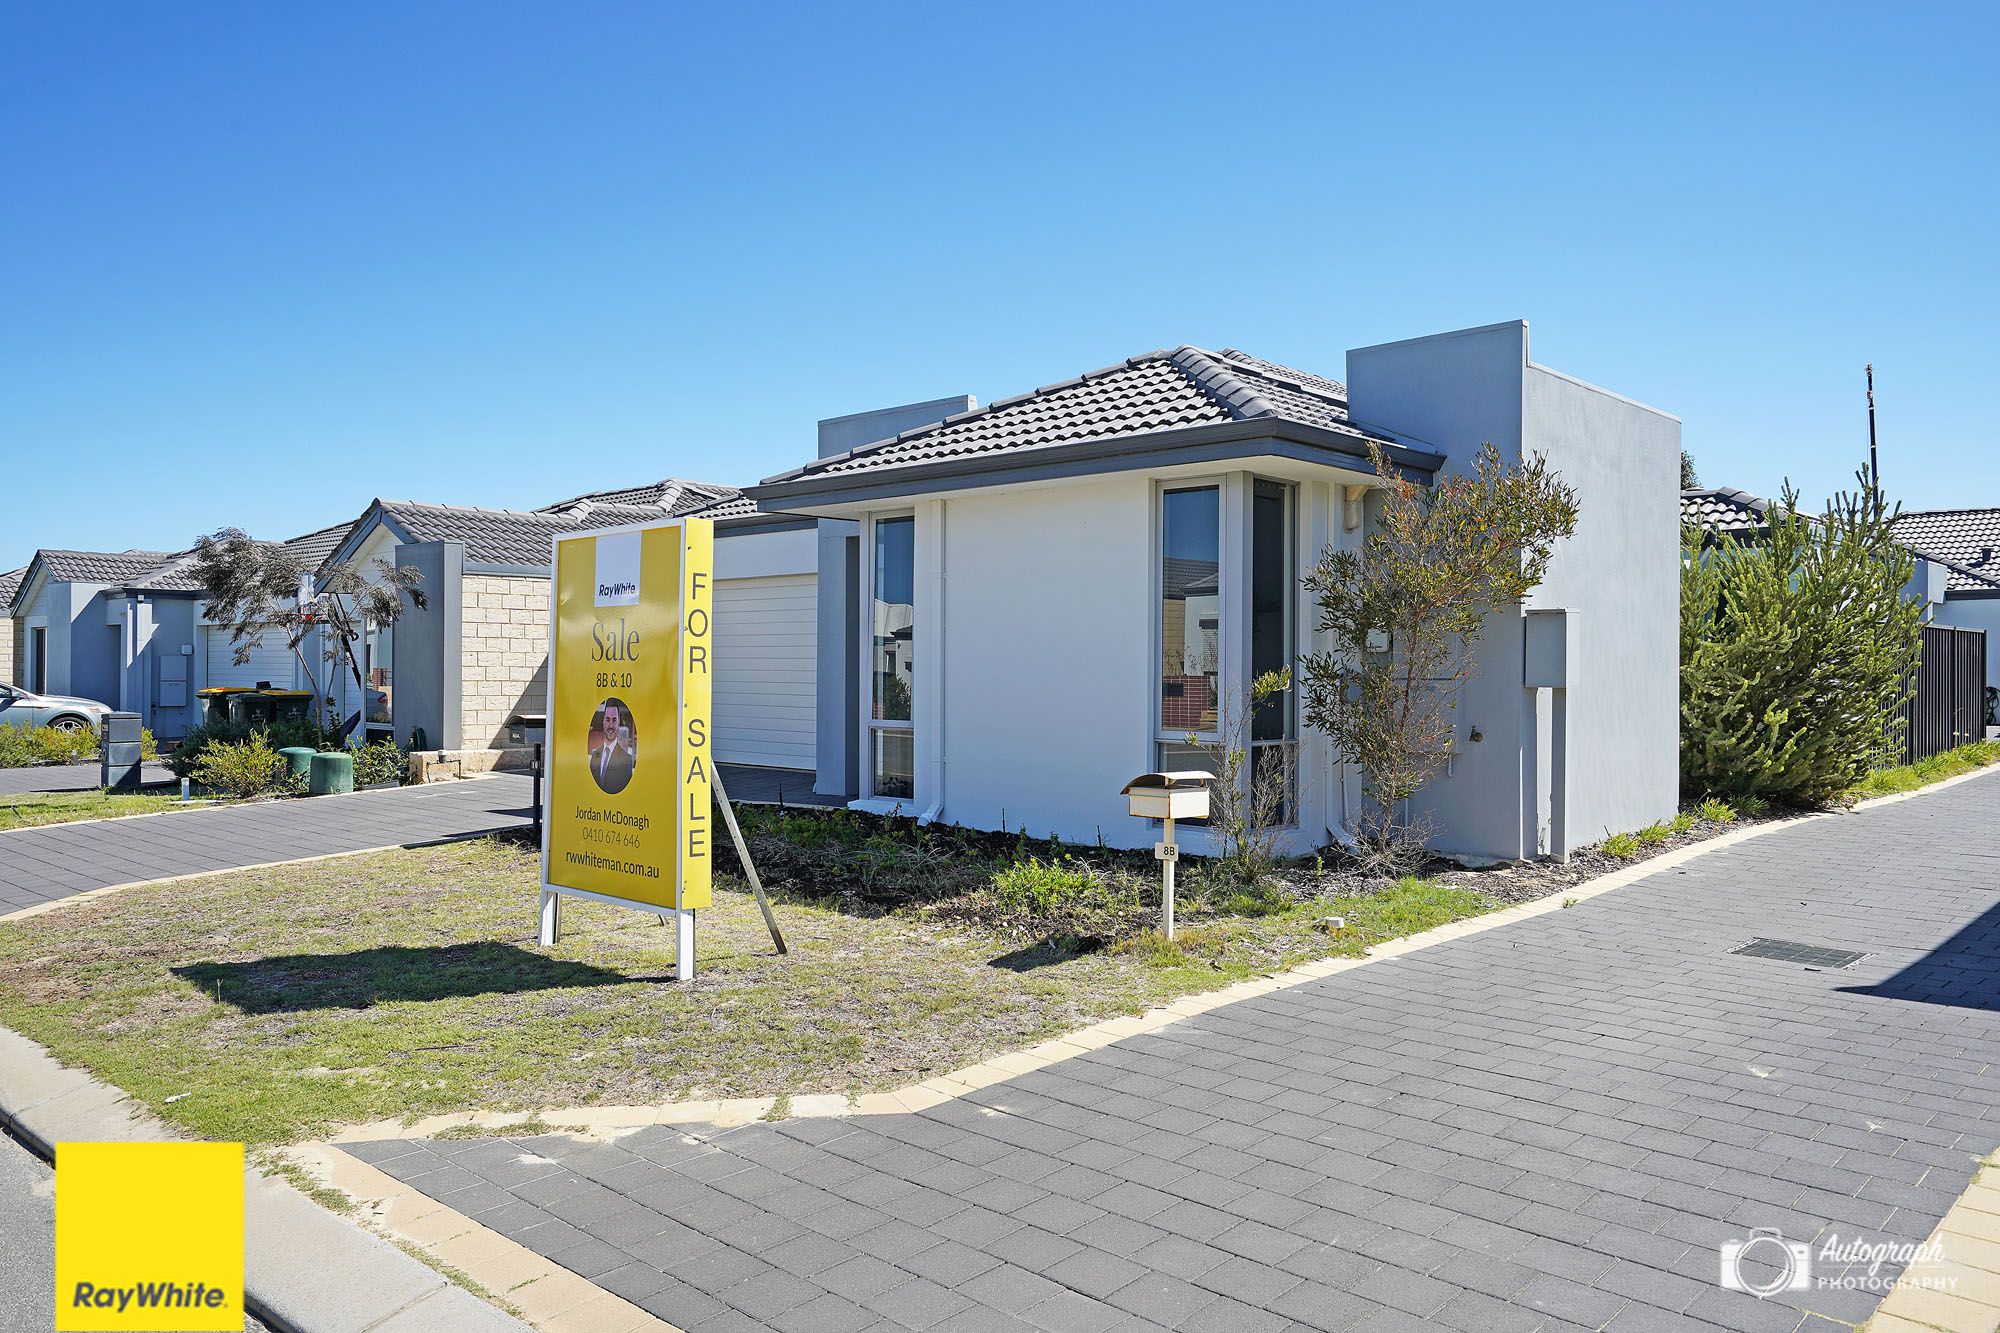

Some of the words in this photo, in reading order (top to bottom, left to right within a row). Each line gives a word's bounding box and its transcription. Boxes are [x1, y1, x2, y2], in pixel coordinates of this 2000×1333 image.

[687, 572, 709, 675] FOR
[591, 617, 640, 662] Sale
[596, 672, 608, 688] 8B
[610, 672, 618, 688] &
[620, 672, 632, 688] 10
[686, 718, 707, 858] SALE
[575, 805, 602, 822] Jordan
[603, 809, 650, 831] McDonagh
[582, 826, 604, 843] 0410
[605, 830, 621, 845] 674
[623, 833, 640, 849] 646
[1163, 845, 1175, 856] 8B
[565, 850, 660, 879] rwwhiteman.com.au
